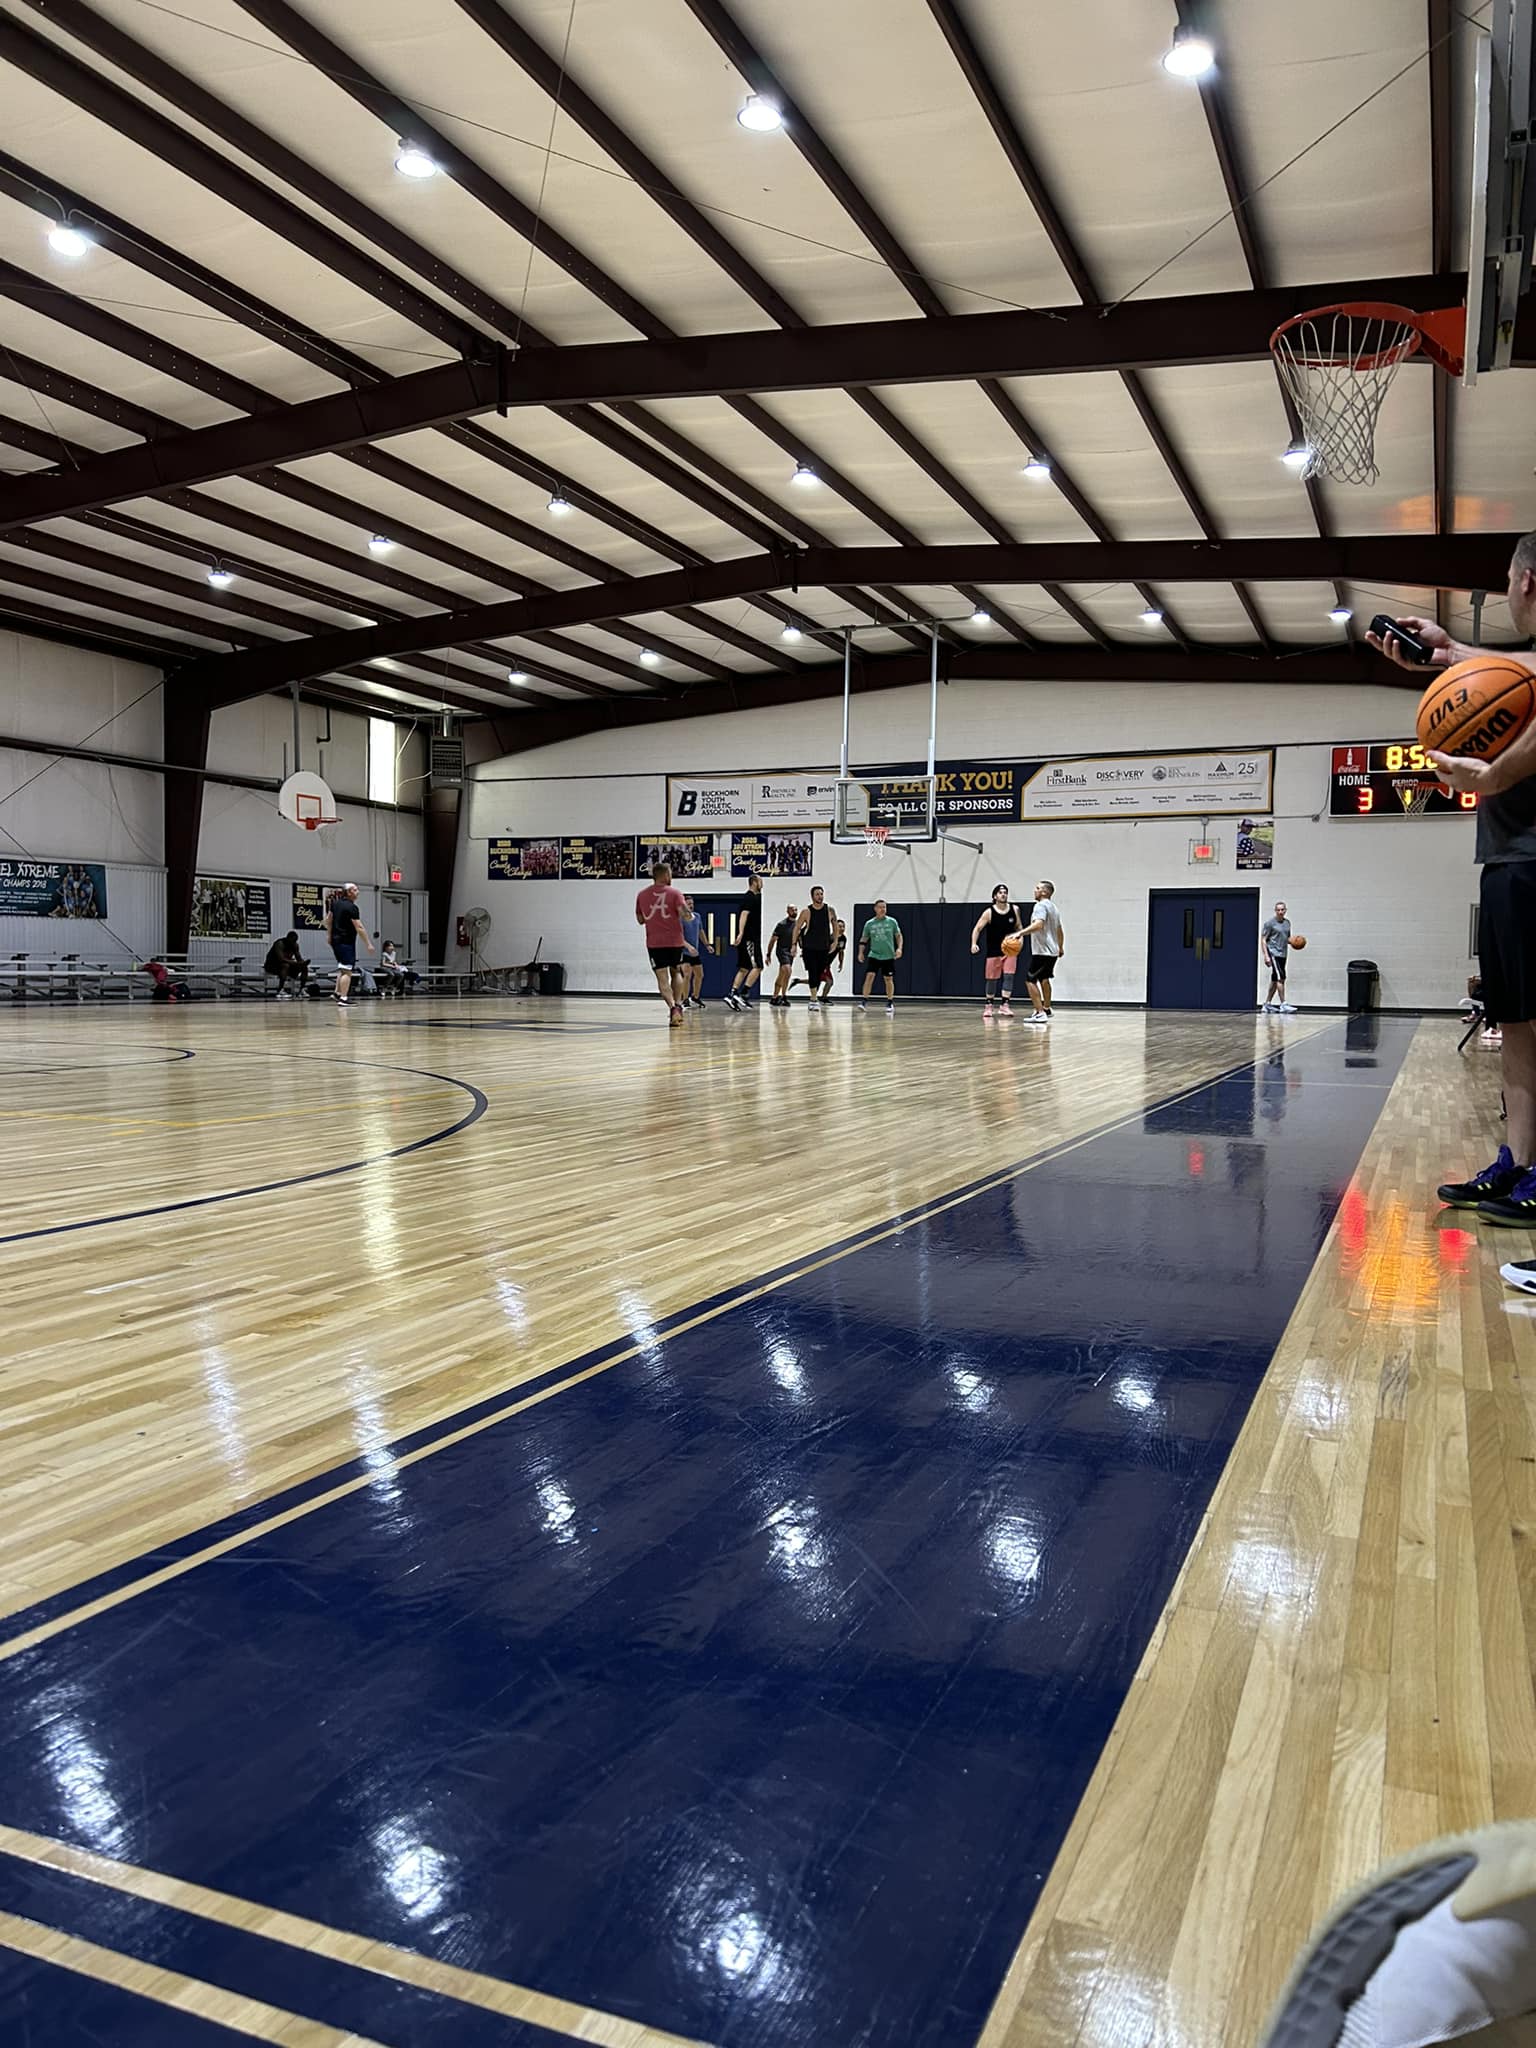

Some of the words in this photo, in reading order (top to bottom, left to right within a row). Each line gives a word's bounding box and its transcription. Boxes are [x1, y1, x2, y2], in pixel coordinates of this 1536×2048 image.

[1430, 688, 1468, 730] EVO
[1238, 762, 1255, 775] 25
[879, 773, 956, 794] THANK
[960, 770, 1013, 791] YOU!
[1047, 774, 1087, 785] FirstBank
[1339, 775, 1370, 786] HOME
[1392, 779, 1419, 787] PERIOD
[677, 790, 698, 816] B
[896, 802, 918, 812] ALL
[948, 798, 1013, 811] SPONSORS
[1358, 787, 1373, 811] 3
[16, 862, 60, 878] XTREME
[3, 879, 31, 888] CHAMPS
[642, 892, 671, 920] A
